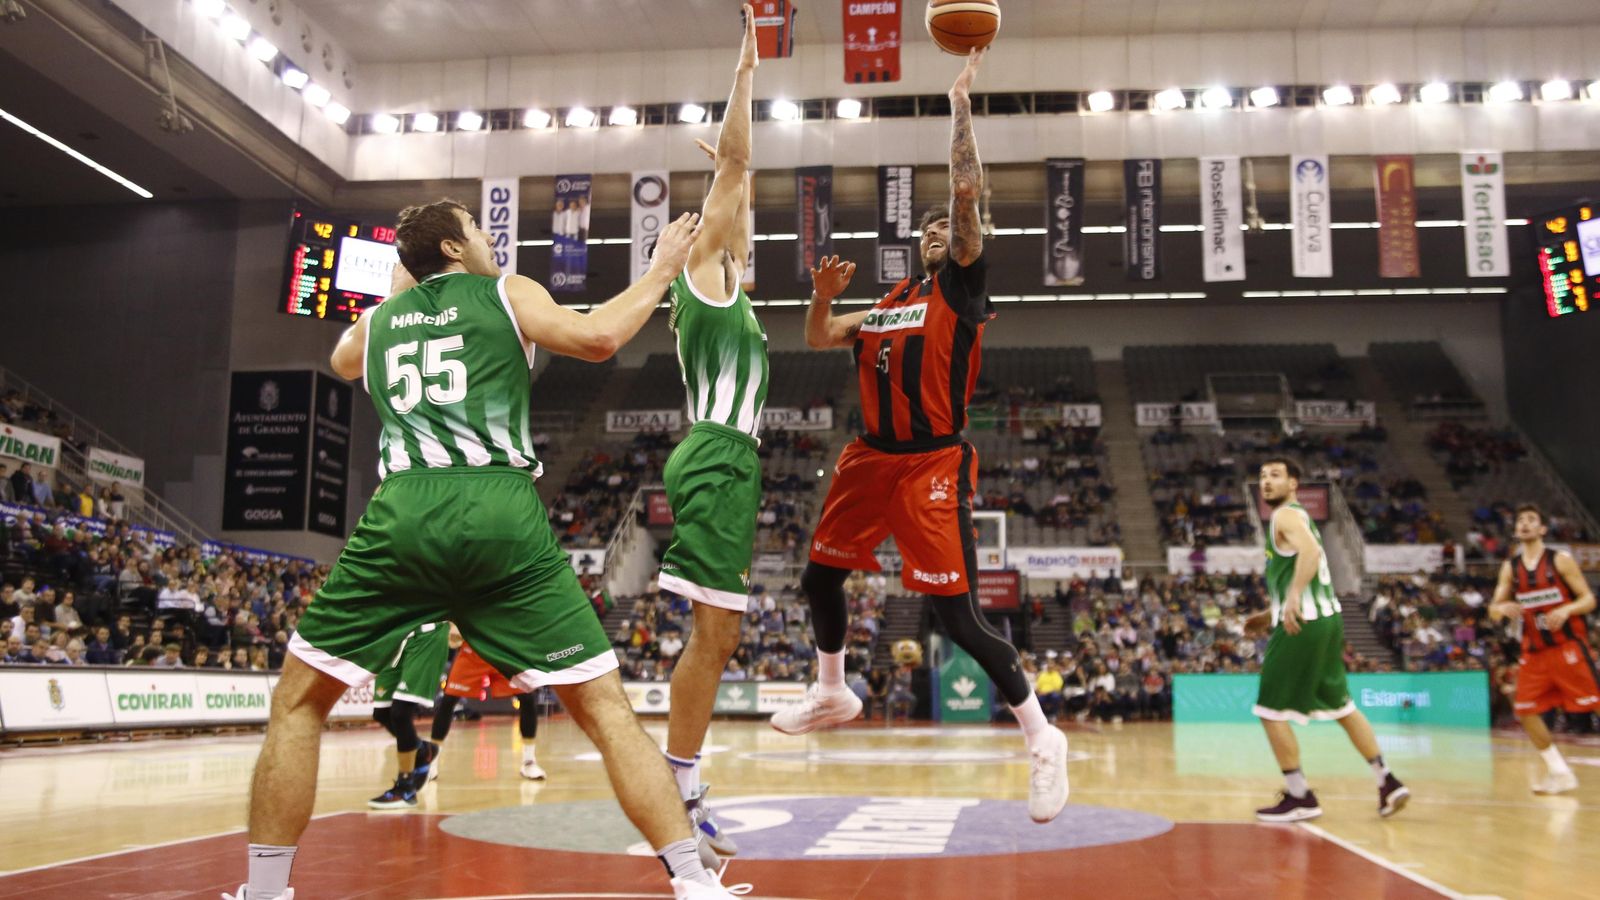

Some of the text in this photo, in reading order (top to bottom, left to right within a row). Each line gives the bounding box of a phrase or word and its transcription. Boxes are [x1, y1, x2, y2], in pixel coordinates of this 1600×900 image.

[849, 2, 896, 15] CAMPEÓN
[1210, 161, 1230, 255] Rossellimac
[1306, 191, 1324, 253] Cuerva
[1473, 183, 1495, 272] fertisac
[344, 254, 397, 272] CENTE
[391, 307, 458, 329] MARCIUS
[862, 309, 924, 327] OVIRAN
[385, 335, 467, 415] 55
[613, 412, 675, 426] IDEAL
[1143, 407, 1209, 419] IDAL
[90, 459, 142, 481] COVIRAN
[546, 643, 584, 662] Kappa
[118, 693, 193, 710] COVIRAN
[205, 693, 266, 709] COVIRAN
